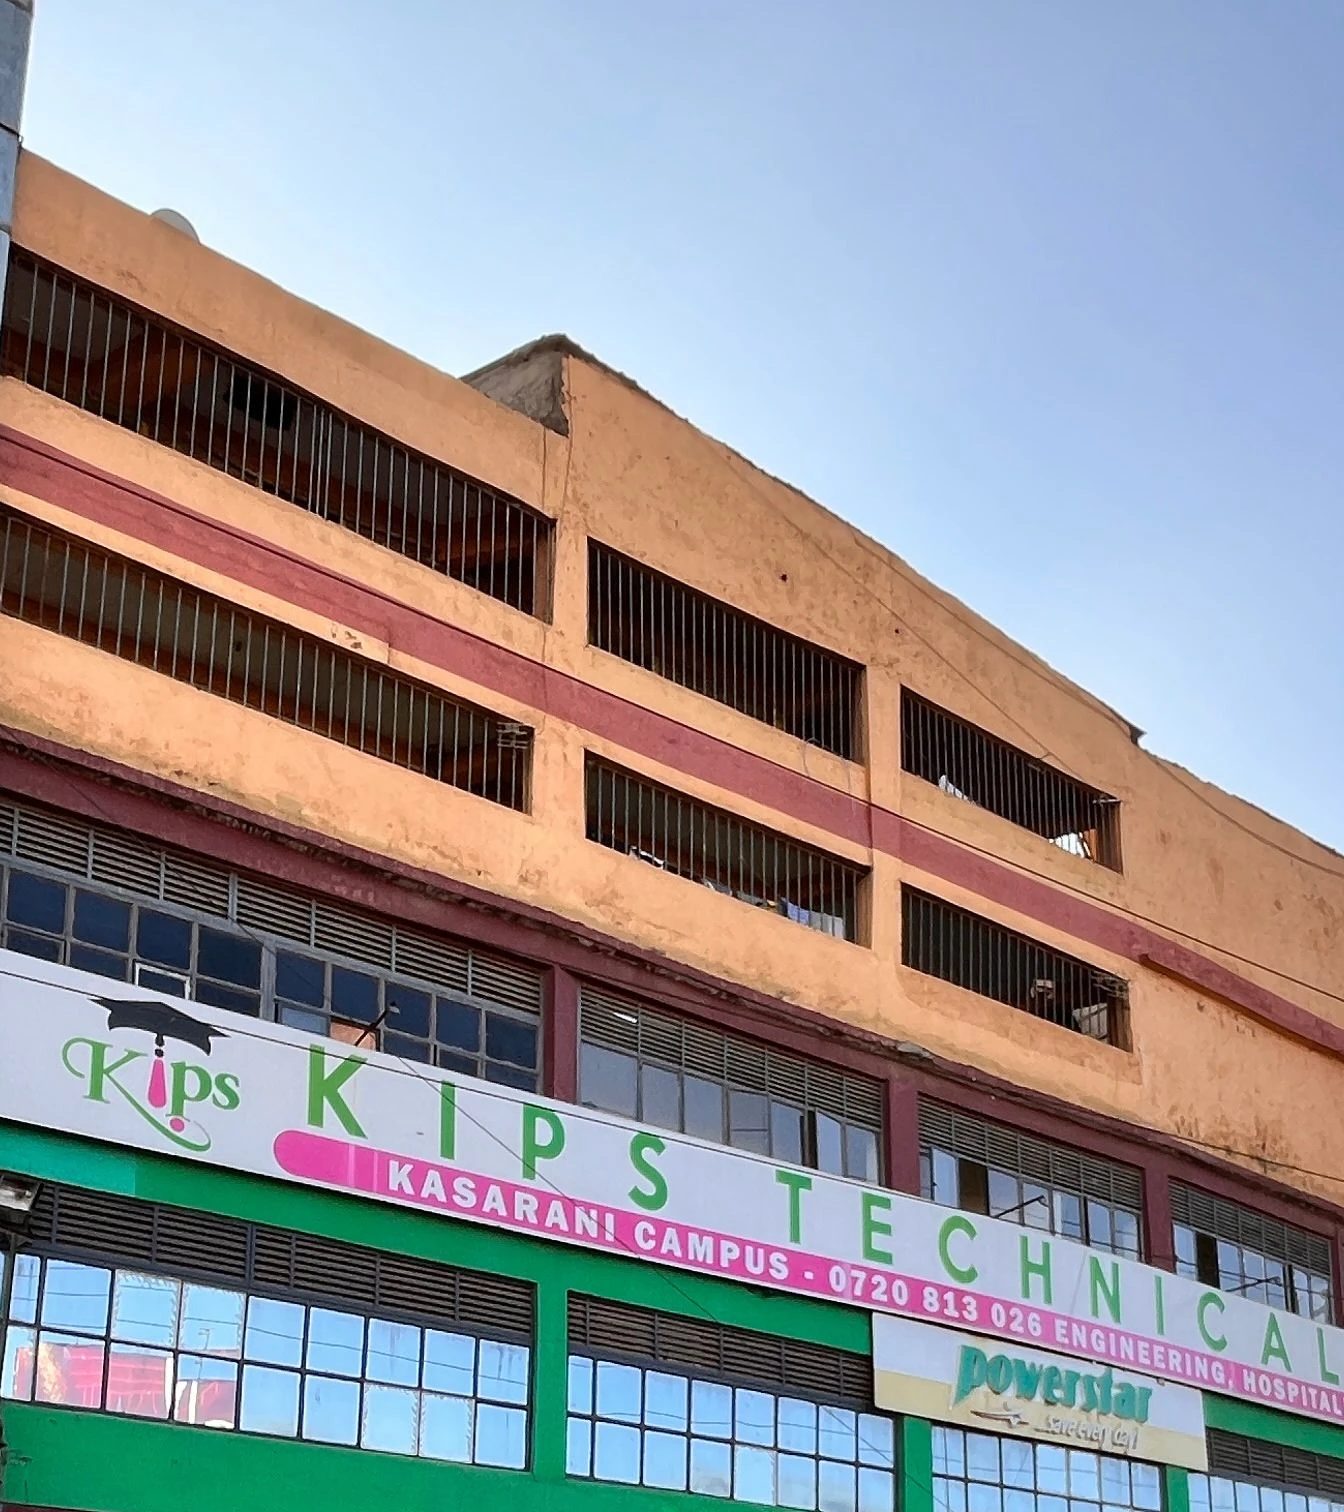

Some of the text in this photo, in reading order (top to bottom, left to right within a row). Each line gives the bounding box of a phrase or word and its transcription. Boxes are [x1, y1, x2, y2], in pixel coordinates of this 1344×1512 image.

[62, 1036, 241, 1152] Kips
[306, 1044, 669, 1211] KIPS
[776, 1170, 1341, 1386] TECHNICAL
[387, 1160, 617, 1251] KASARANI
[632, 1222, 791, 1281] CAMPUS
[828, 1265, 909, 1308] 0720
[922, 1285, 979, 1322] 813
[990, 1304, 1042, 1338] 026
[1055, 1317, 1234, 1387] ENGINEERING,
[951, 1344, 1153, 1423] powerstar
